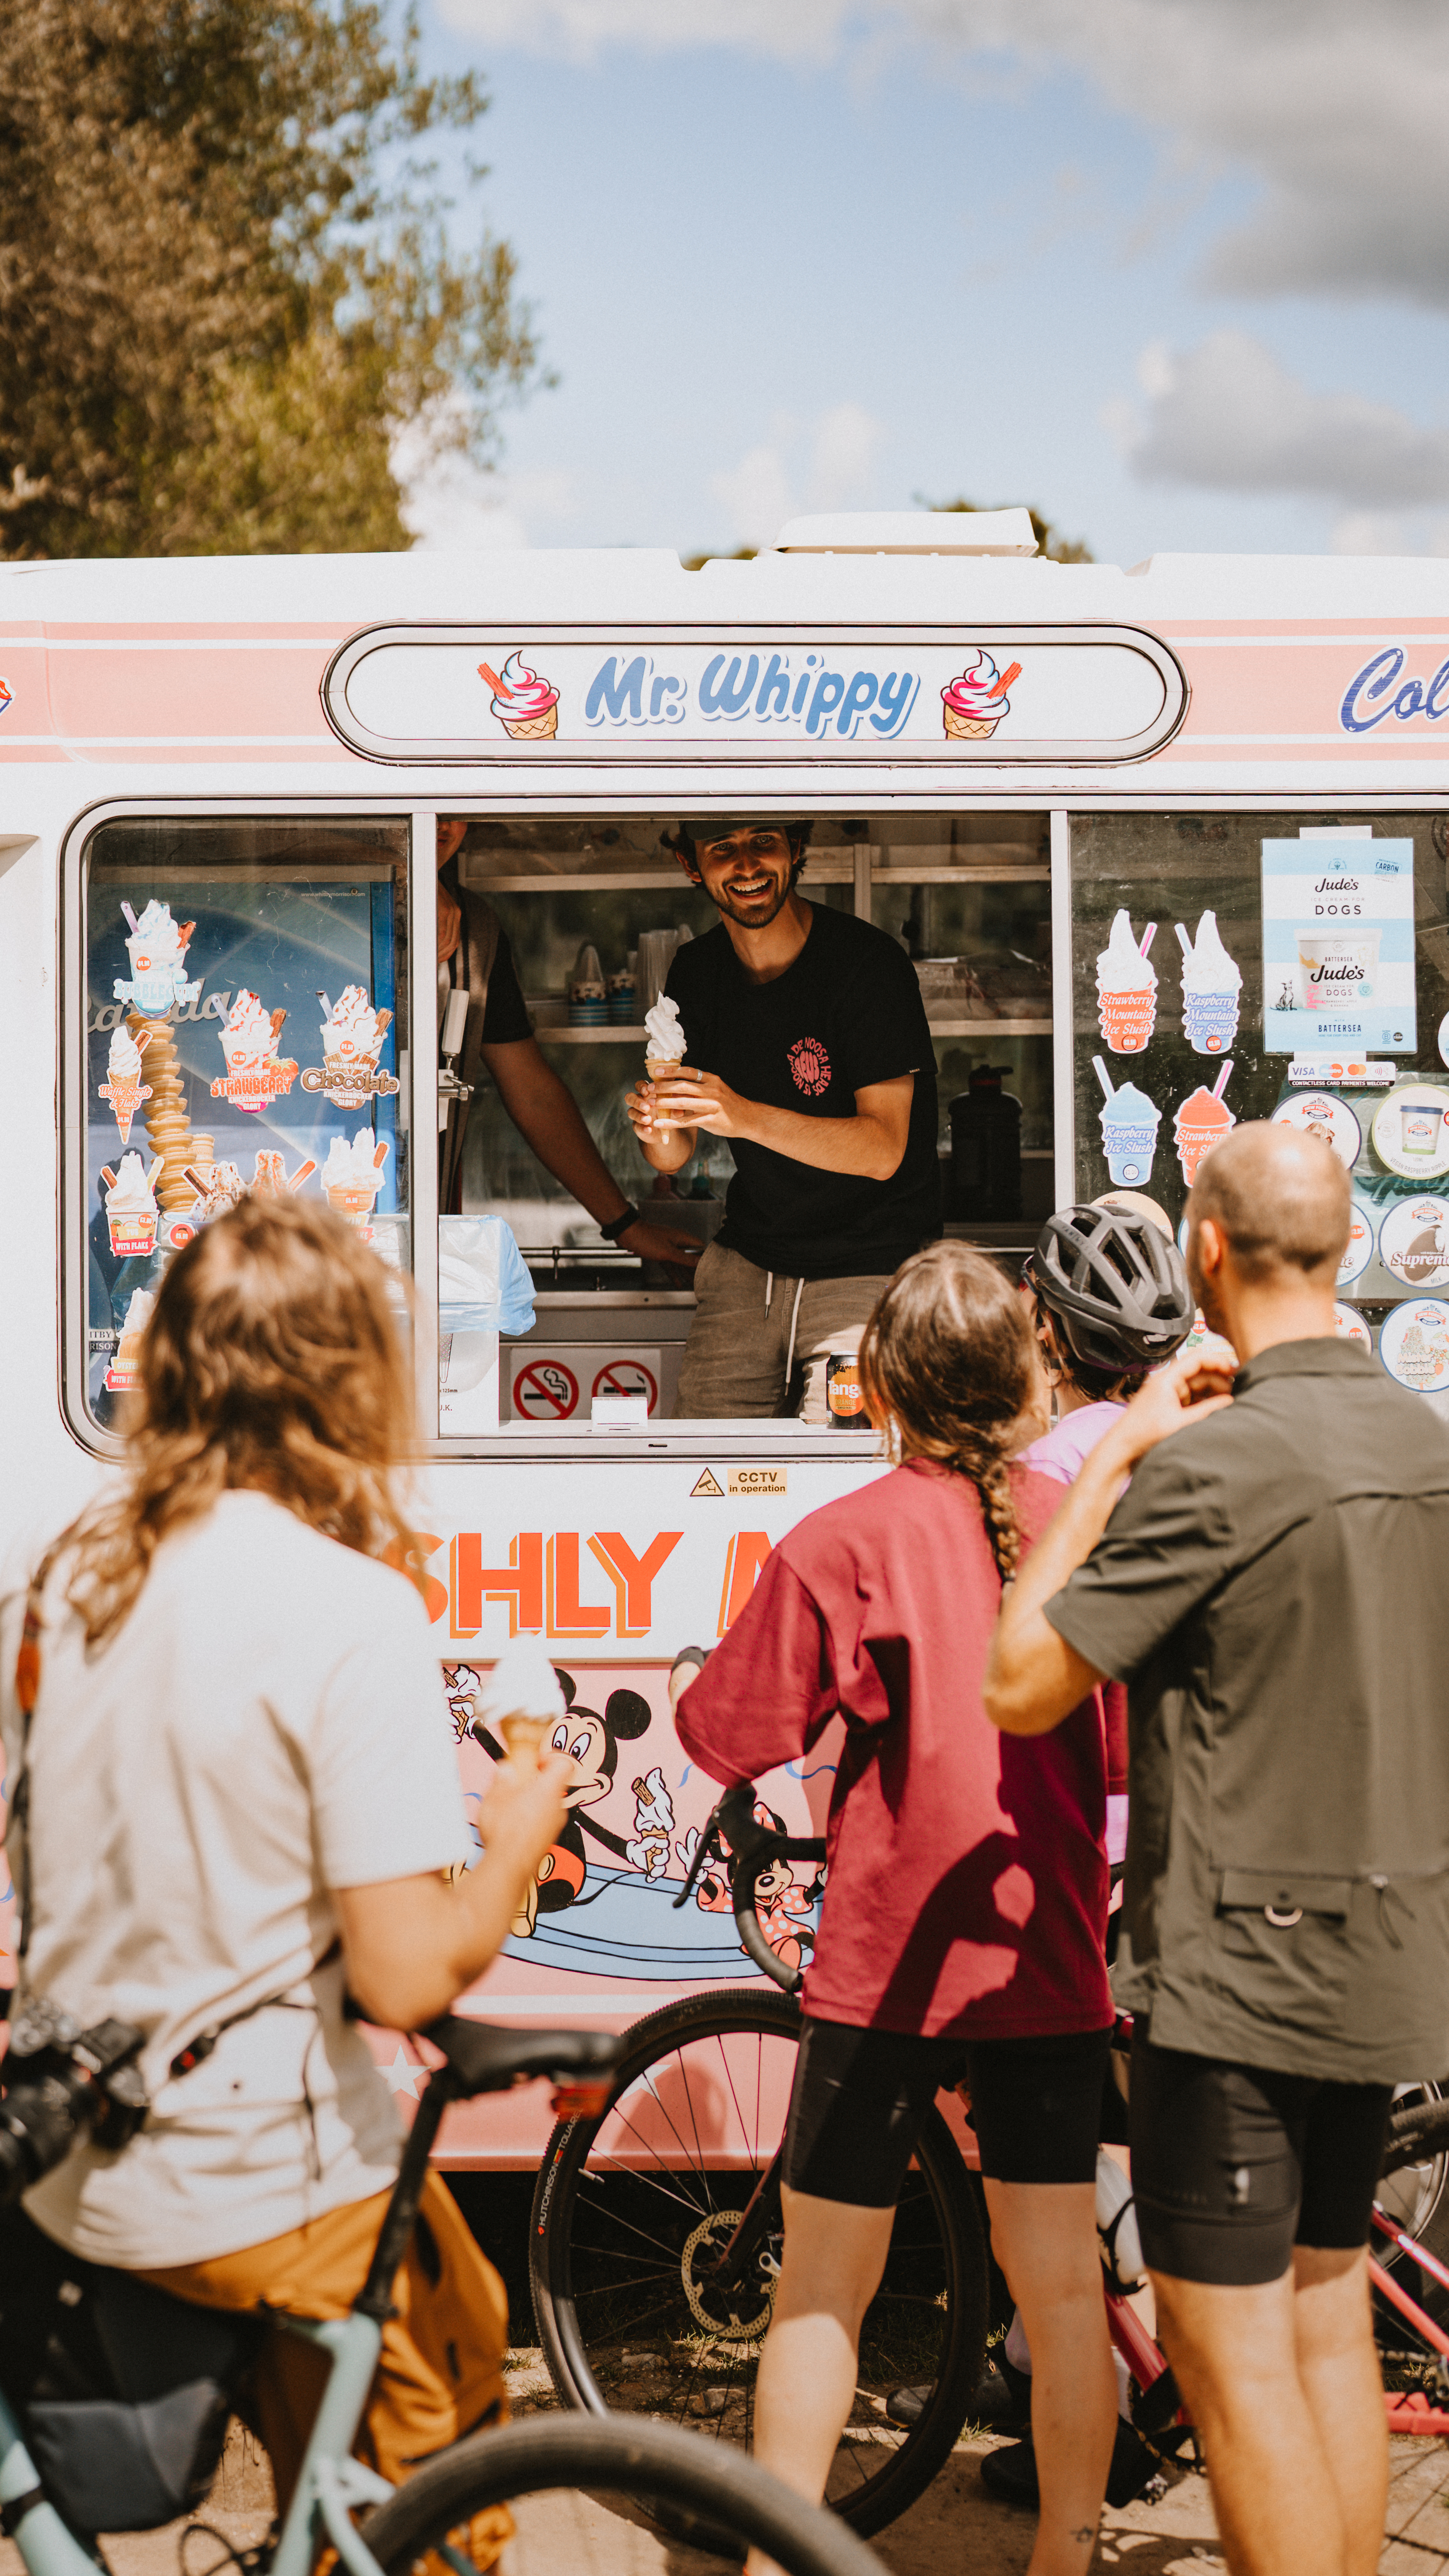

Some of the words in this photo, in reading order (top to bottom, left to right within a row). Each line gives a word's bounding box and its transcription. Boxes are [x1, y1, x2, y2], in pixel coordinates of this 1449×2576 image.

[585, 656, 686, 724] Mr.
[699, 654, 920, 739] Whippy
[1376, 862, 1399, 873] CARBON
[1315, 878, 1359, 893] Jude's
[1315, 905, 1361, 915] DOGS
[1310, 965, 1365, 982] Jude's
[115, 982, 199, 1002] BUBBLEGUM
[1100, 993, 1153, 1008] Strawberry
[1186, 994, 1236, 1009] Raspberry
[1101, 1008, 1153, 1022] Mountain
[1185, 1008, 1236, 1022] Mountain
[1104, 1023, 1121, 1036] Ice
[1122, 1023, 1151, 1035] Slush
[1188, 1024, 1204, 1036] Ice
[1205, 1023, 1234, 1035] Slush
[805, 1037, 829, 1064] NOOSA
[329, 1061, 353, 1069] FRESHLY
[211, 1076, 292, 1097] STRAWBERRY
[303, 1069, 398, 1094] Chocolate
[812, 1065, 831, 1096] HEADS
[101, 1086, 125, 1098] Waffle
[126, 1087, 151, 1098] Single
[324, 1091, 373, 1100] KNICKERBOCKER
[111, 1098, 119, 1108] &
[118, 1098, 140, 1108] Flake
[228, 1095, 276, 1104] KNICKERBOCKER
[1315, 1105, 1332, 1115] FOREST
[1105, 1126, 1154, 1141] Raspberry
[1106, 1141, 1123, 1154] Ice
[1124, 1141, 1153, 1153] Slush
[1180, 1144, 1197, 1156] Ice
[1390, 1157, 1404, 1169] VEGAN
[1404, 1166, 1431, 1174] RASPBERRY
[1431, 1160, 1447, 1171] RIPPLE
[1424, 1209, 1441, 1217] FOREST
[345, 1217, 362, 1225] WIN
[116, 1242, 130, 1250] WITH
[131, 1241, 149, 1250] FLAKE
[1339, 1268, 1356, 1281] CRUNCH
[1431, 1276, 1442, 1284] MILK
[1428, 1312, 1444, 1321] FOREST
[1397, 1352, 1433, 1364] Mister
[117, 1362, 139, 1370] OYSTE
[1396, 1363, 1435, 1375] Bobble
[111, 1375, 126, 1383] WITH
[738, 1472, 778, 1482] CCTV
[741, 1484, 786, 1494] operation
[382, 1532, 685, 1638] SHLY
[558, 2110, 583, 2149] TOUARE
[539, 2161, 559, 2226] HUTCHINSON
